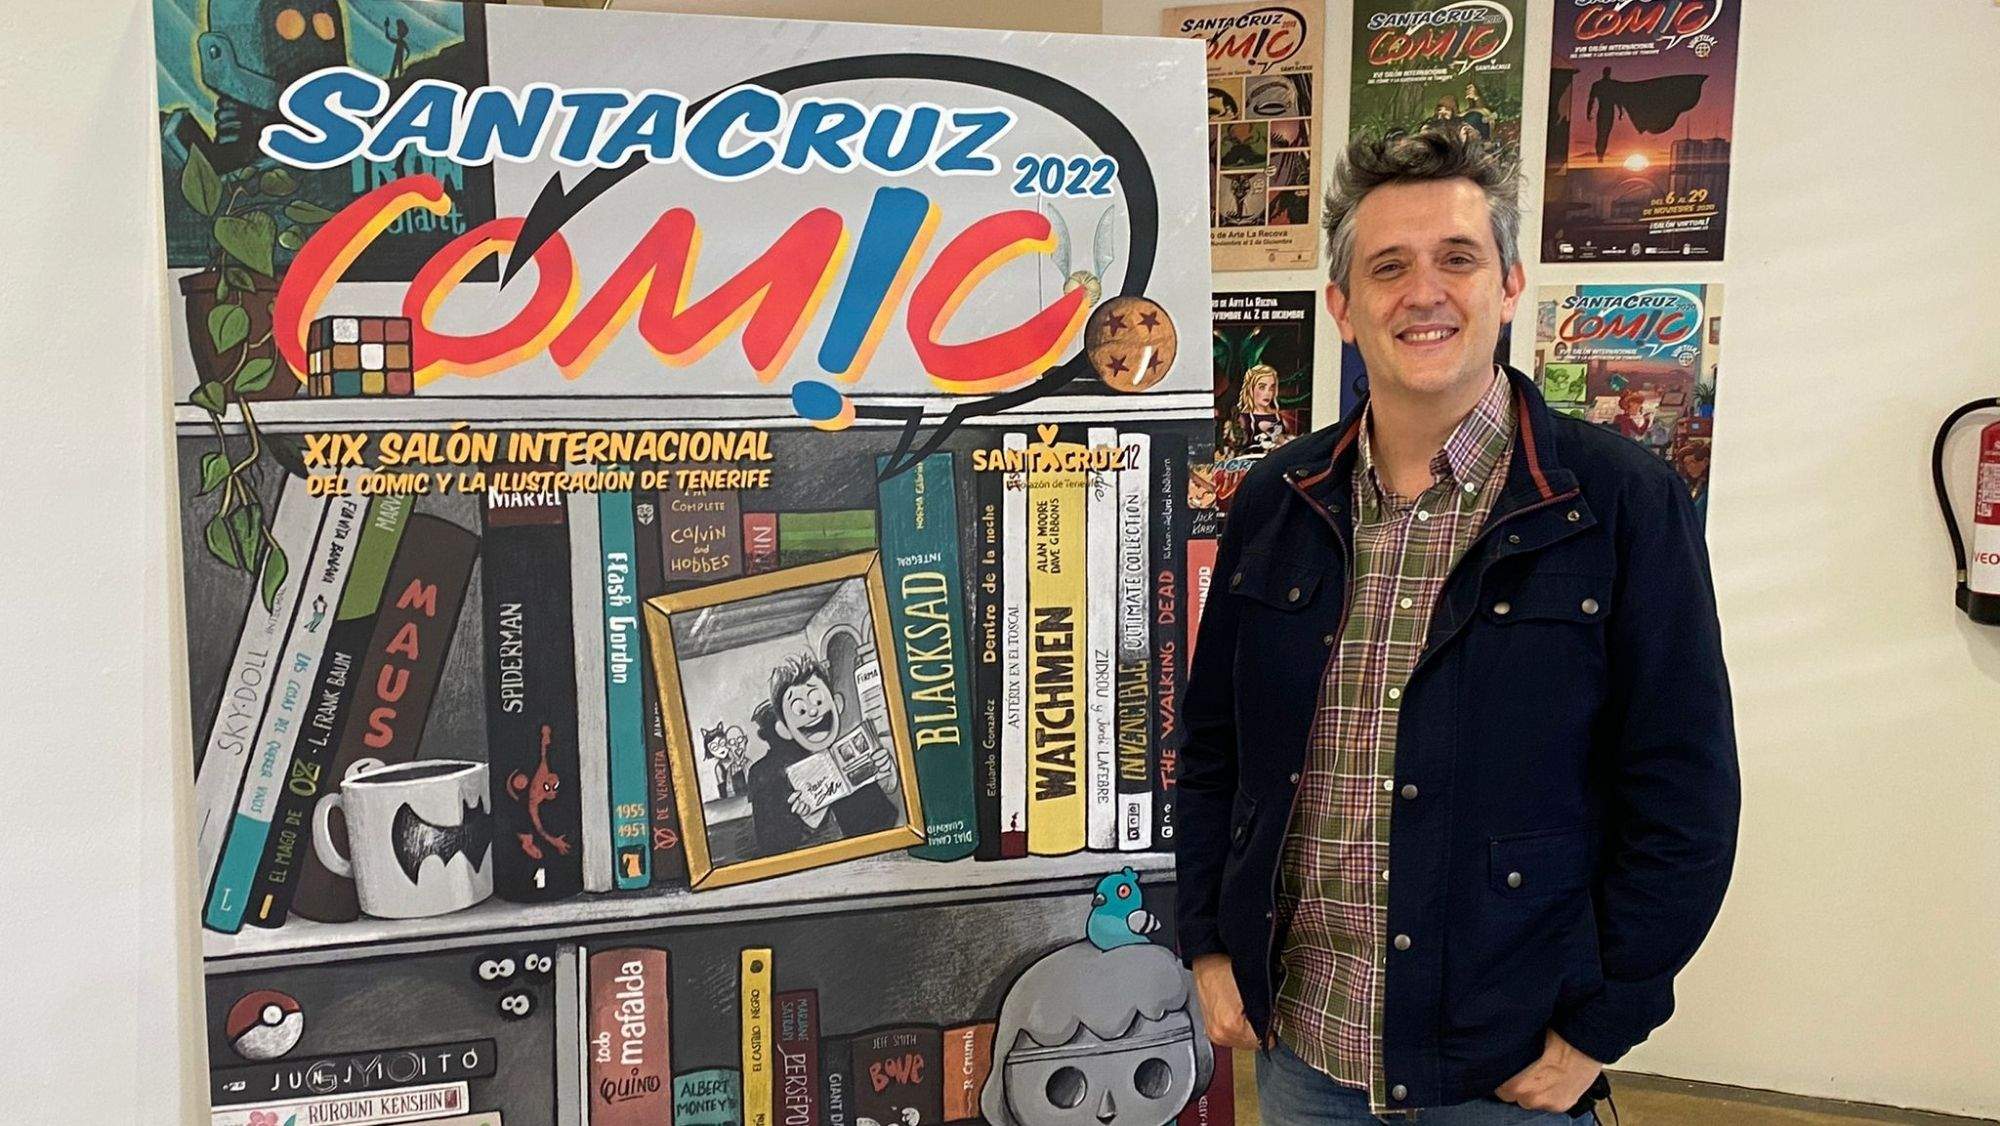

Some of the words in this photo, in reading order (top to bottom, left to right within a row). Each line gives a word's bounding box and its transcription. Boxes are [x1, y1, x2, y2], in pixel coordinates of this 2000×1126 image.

[1181, 14, 1283, 32] SANTACRUZ
[1368, 8, 1488, 30] SANTACRUZ
[260, 66, 1017, 182] SANTACRUZ
[1012, 154, 1118, 199] 2022
[1666, 191, 1675, 204] 6
[1688, 189, 1708, 204] 29
[1254, 308, 1260, 320] 2
[1562, 295, 1679, 310] SANTACRUZ
[303, 433, 368, 467] XIX
[378, 421, 499, 465] SALÓN
[507, 430, 774, 465] INTERNACIONAL
[972, 446, 1127, 473] SANTACRUZ
[1125, 444, 1140, 470] 12
[306, 470, 348, 497] DEL
[357, 464, 428, 495] CÓMIC
[435, 472, 455, 494] Y
[458, 471, 487, 494] LA
[493, 464, 634, 493] ILUSTRACIÓN
[641, 469, 670, 491] DE
[676, 468, 771, 490] TENERIFE
[488, 485, 563, 509] MARVEL
[671, 499, 726, 512] COMPLETE
[982, 503, 996, 544] noche
[1036, 500, 1049, 538] MOORE
[1050, 498, 1061, 546] GIBBONS
[694, 544, 710, 554] and
[1124, 494, 1143, 573] COLLECTION
[897, 552, 942, 568] INTEGRAL
[982, 550, 996, 565] la
[1037, 544, 1049, 573] ALAN
[1051, 549, 1062, 574] DAVE
[607, 552, 633, 608] Flash
[982, 572, 997, 595] de
[1157, 570, 1176, 626] DEAD
[1007, 603, 1020, 647] TOSCAL
[1124, 578, 1144, 650] ULTIMATE
[609, 616, 637, 684] Gordon
[982, 603, 997, 664] Dentro
[363, 578, 438, 750] MAUS
[500, 602, 525, 713] SPIDERMAN
[902, 571, 961, 750] BLACKSAD
[1008, 663, 1020, 677] EN
[1094, 650, 1110, 699] ZIDROU
[857, 668, 879, 685] FIRMA
[1159, 641, 1176, 740] WALKING
[1006, 681, 1020, 730] ASTÉRIX
[1035, 606, 1077, 801] WATCHMEN
[1090, 704, 1104, 713] y
[1118, 659, 1150, 782] INVENCIBLE
[289, 758, 322, 798] OZ
[983, 755, 997, 798] Eduardo
[1096, 750, 1110, 805] LAFEBRE
[1160, 748, 1177, 791] THE
[288, 809, 303, 827] DE
[616, 803, 645, 819] 1955
[274, 830, 296, 867] MAGO
[269, 867, 287, 884] EL
[532, 867, 546, 889] 1
[614, 960, 647, 1066] mafalda
[591, 1031, 612, 1063] todo
[309, 1099, 374, 1125] RUROUNI
[380, 1089, 443, 1116] KENSHIN
[680, 1079, 730, 1098] ALBERT
[828, 1073, 843, 1111] GIANT
